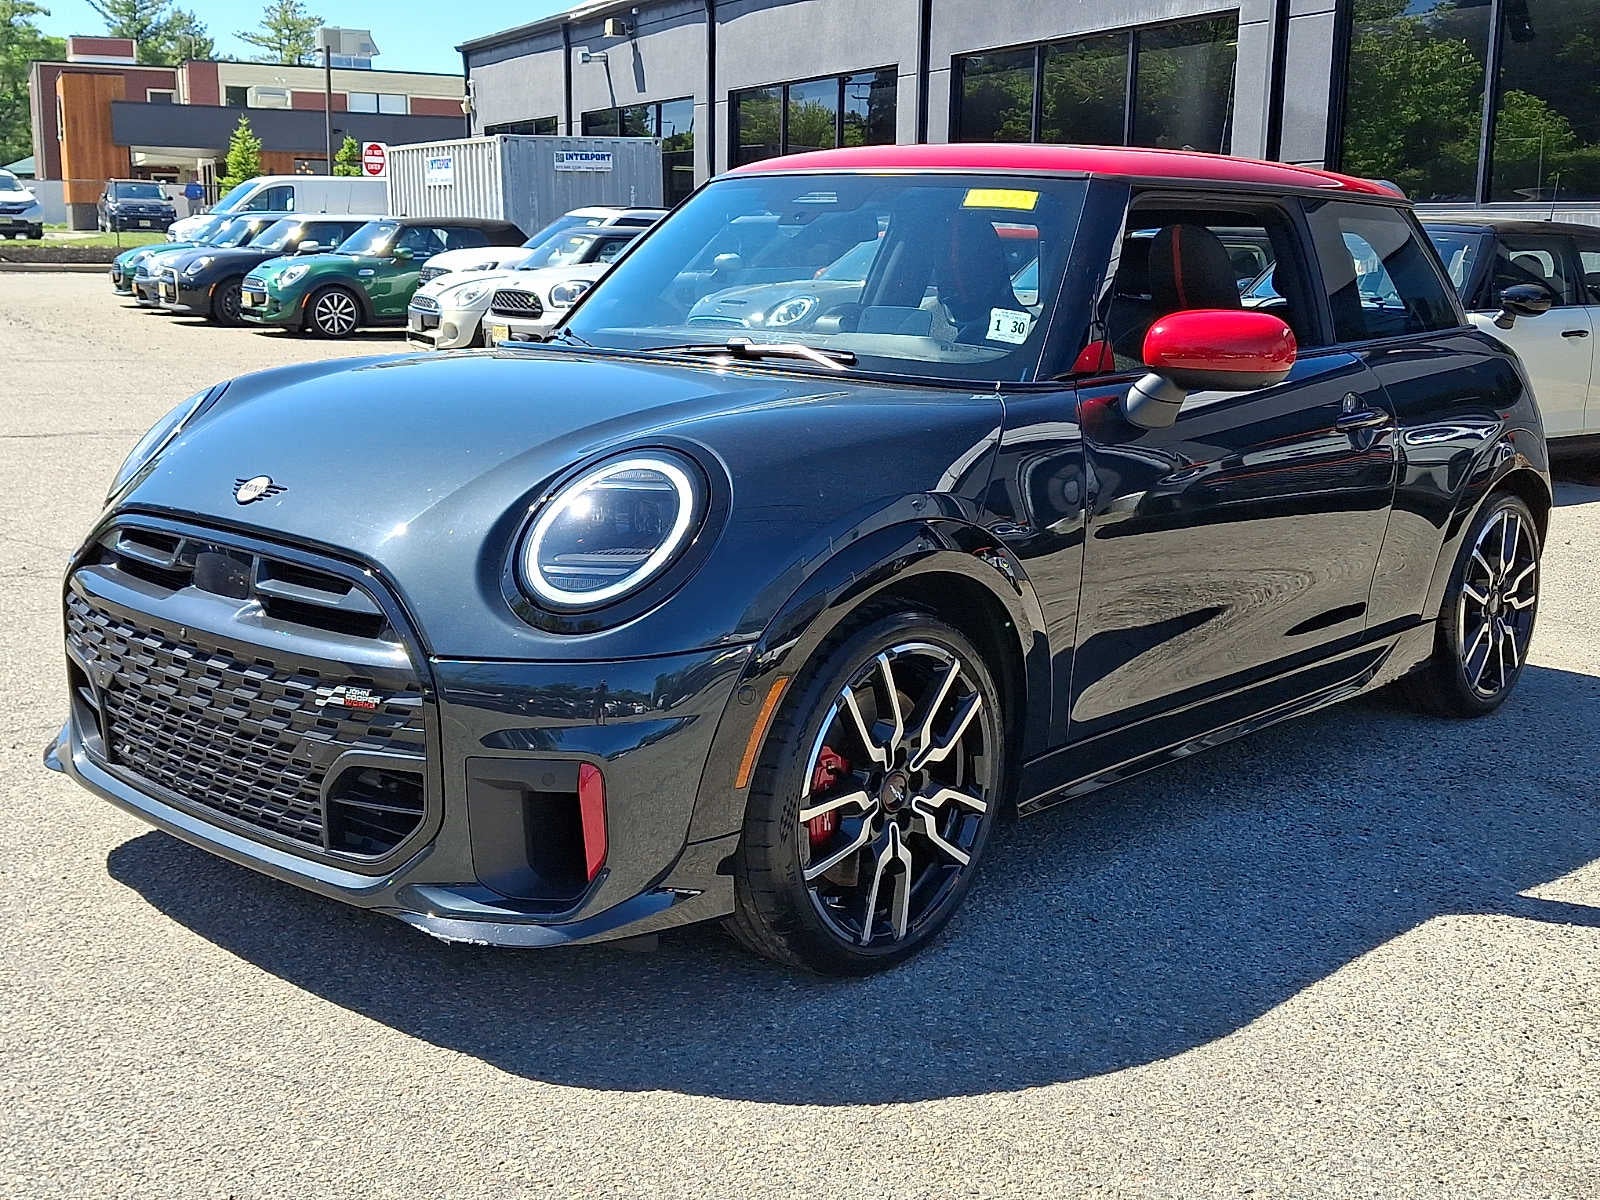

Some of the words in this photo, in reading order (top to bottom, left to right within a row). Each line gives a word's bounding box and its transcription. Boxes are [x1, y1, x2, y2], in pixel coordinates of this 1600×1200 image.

[566, 153, 611, 161] INTERPORT
[994, 319, 1001, 331] 1
[1011, 321, 1025, 334] 30
[345, 688, 370, 697] JOHN
[344, 699, 376, 709] WORKS
[345, 694, 381, 705] COOPER
